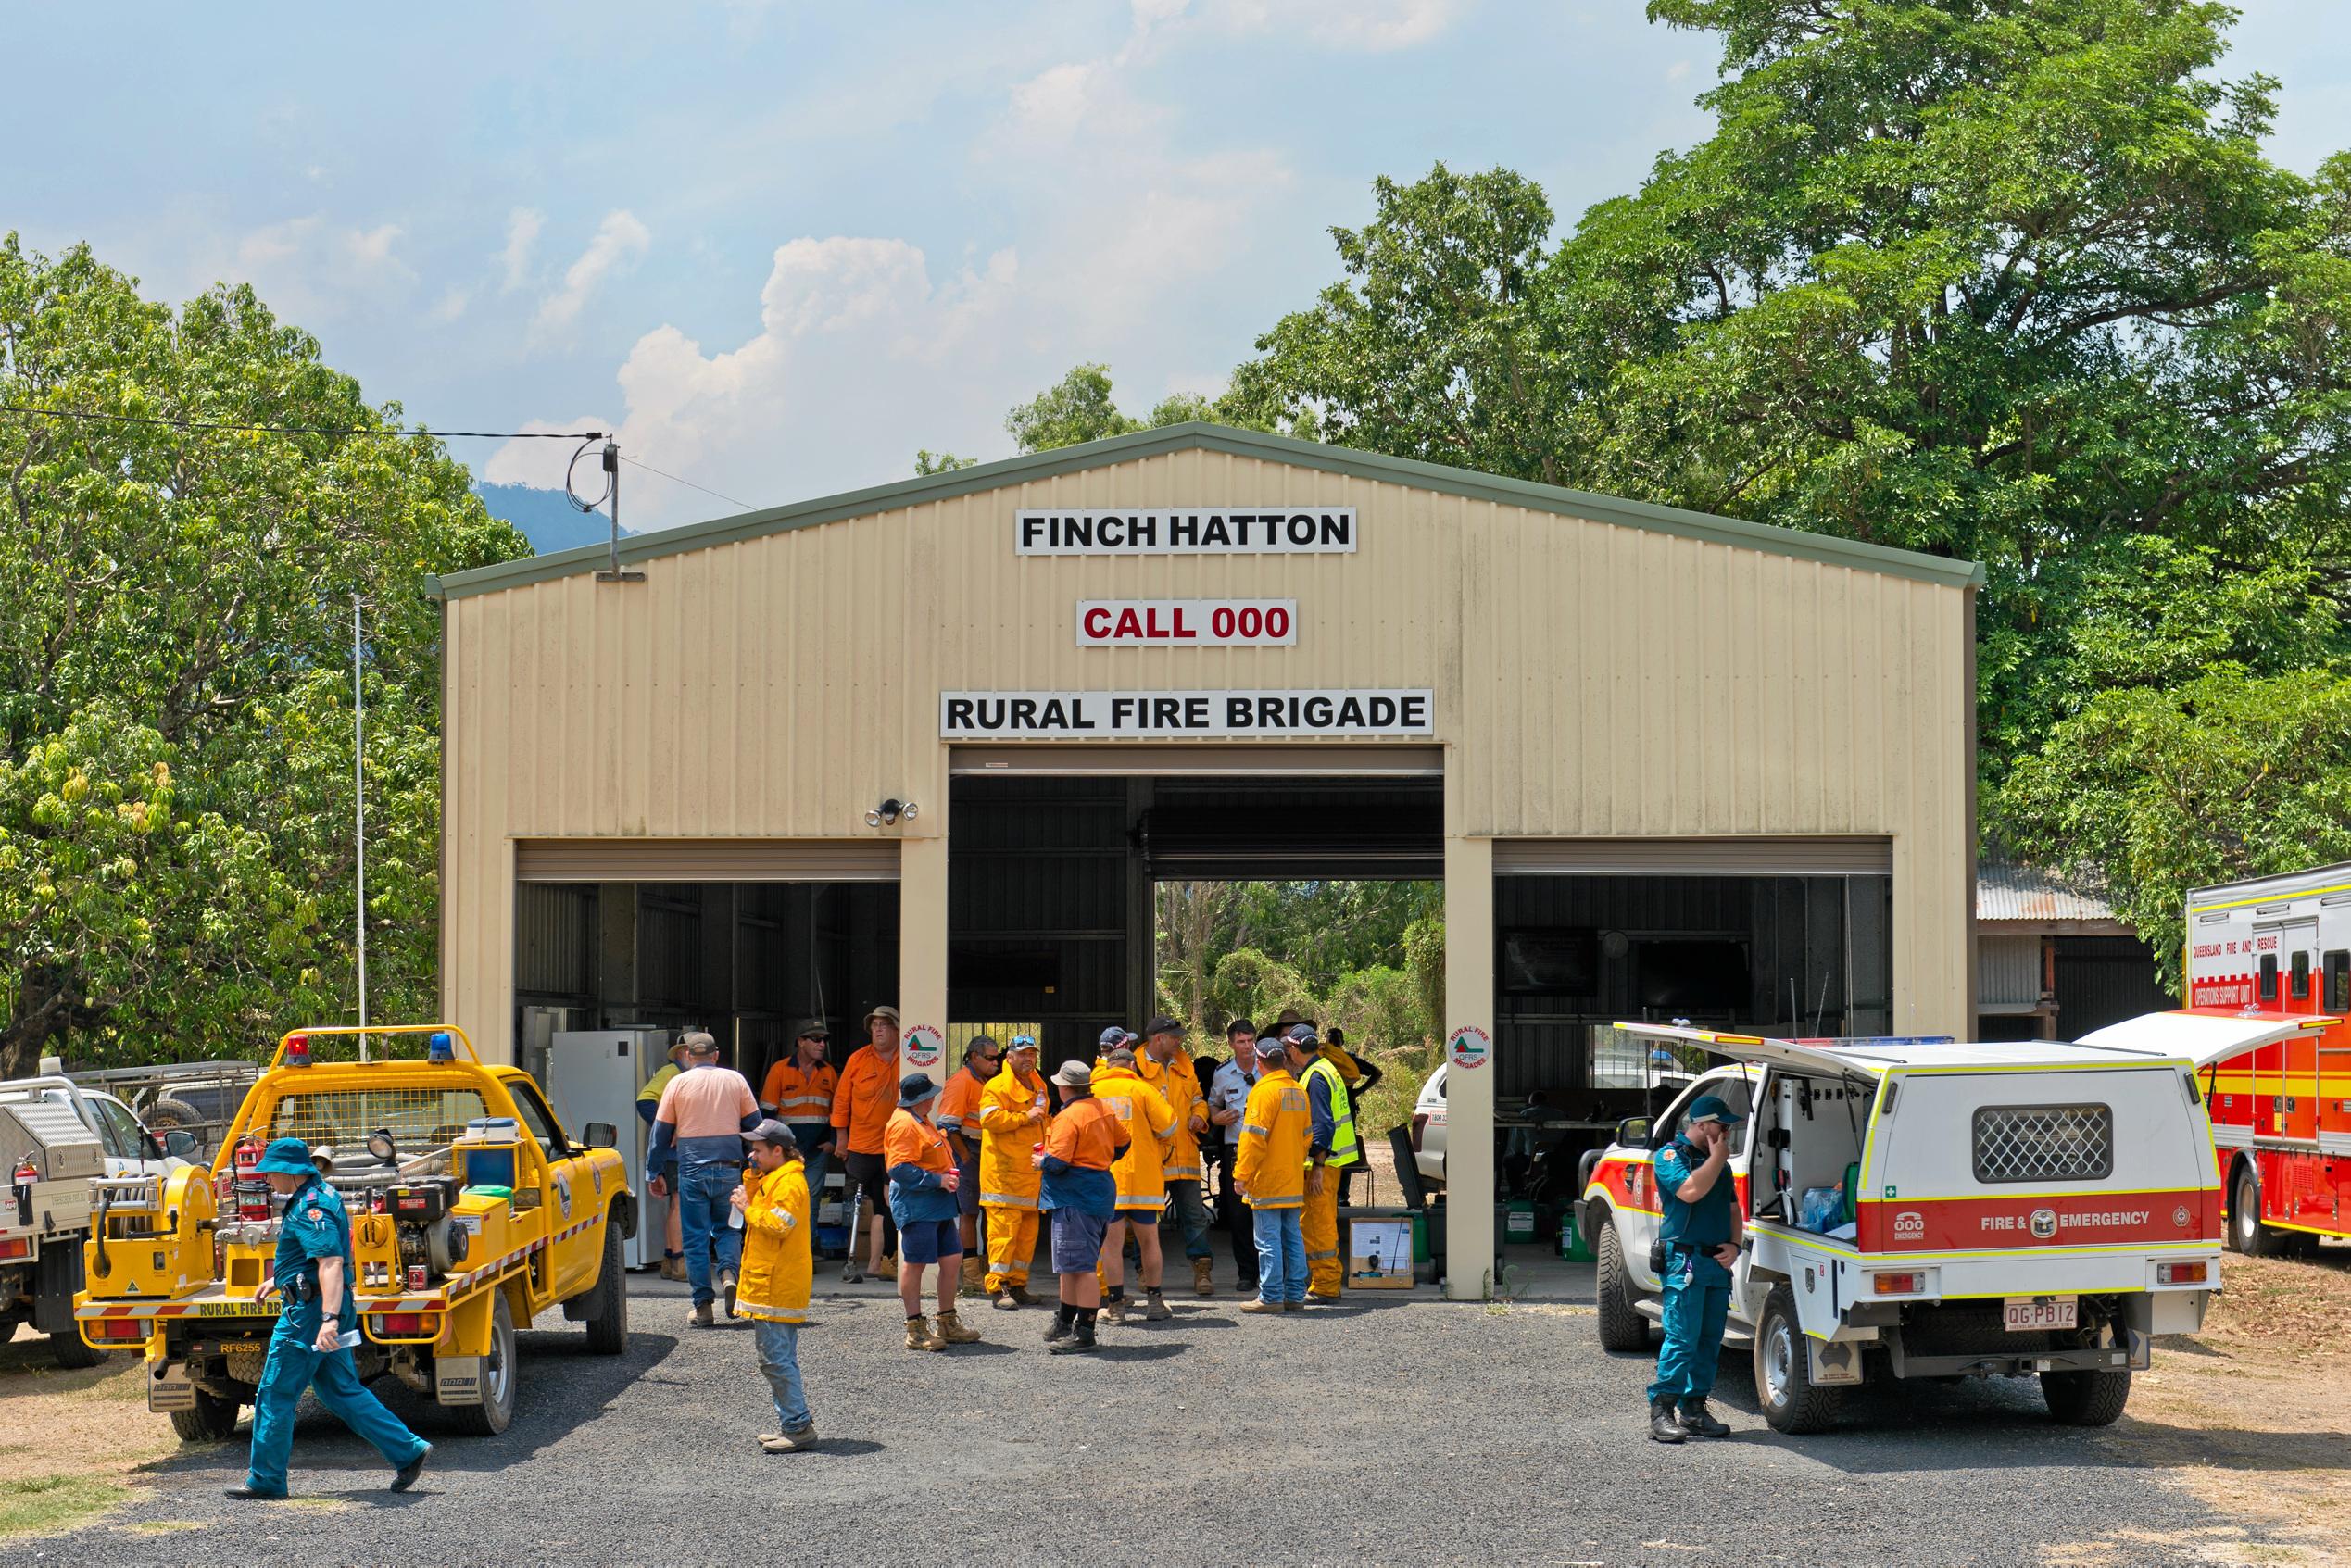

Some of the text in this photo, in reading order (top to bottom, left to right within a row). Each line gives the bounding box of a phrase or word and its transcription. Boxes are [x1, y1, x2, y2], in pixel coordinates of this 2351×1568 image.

[1023, 514, 1350, 547] FINCH HATTON
[1084, 607, 1289, 638] CALL 000
[947, 696, 1427, 730] RURAL FIRE BRIGADE
[2194, 936, 2277, 958] QUEENSLAND FIRE AND RESCUE
[2195, 985, 2250, 1006] OPERATIONS SUPPORT UNIT
[904, 1025, 942, 1040] RURAL FIRE
[1450, 1026, 1490, 1042] RURAL FIRE
[907, 1055, 939, 1067] BRIGADES
[1453, 1058, 1487, 1069] BRIGADES
[1981, 1211, 2150, 1230] FIRE & EMERGENCY
[1894, 1232, 1924, 1240] EMERGENCY
[200, 1302, 282, 1316] RURAL FIRE BR
[220, 1343, 261, 1353] RF6255
